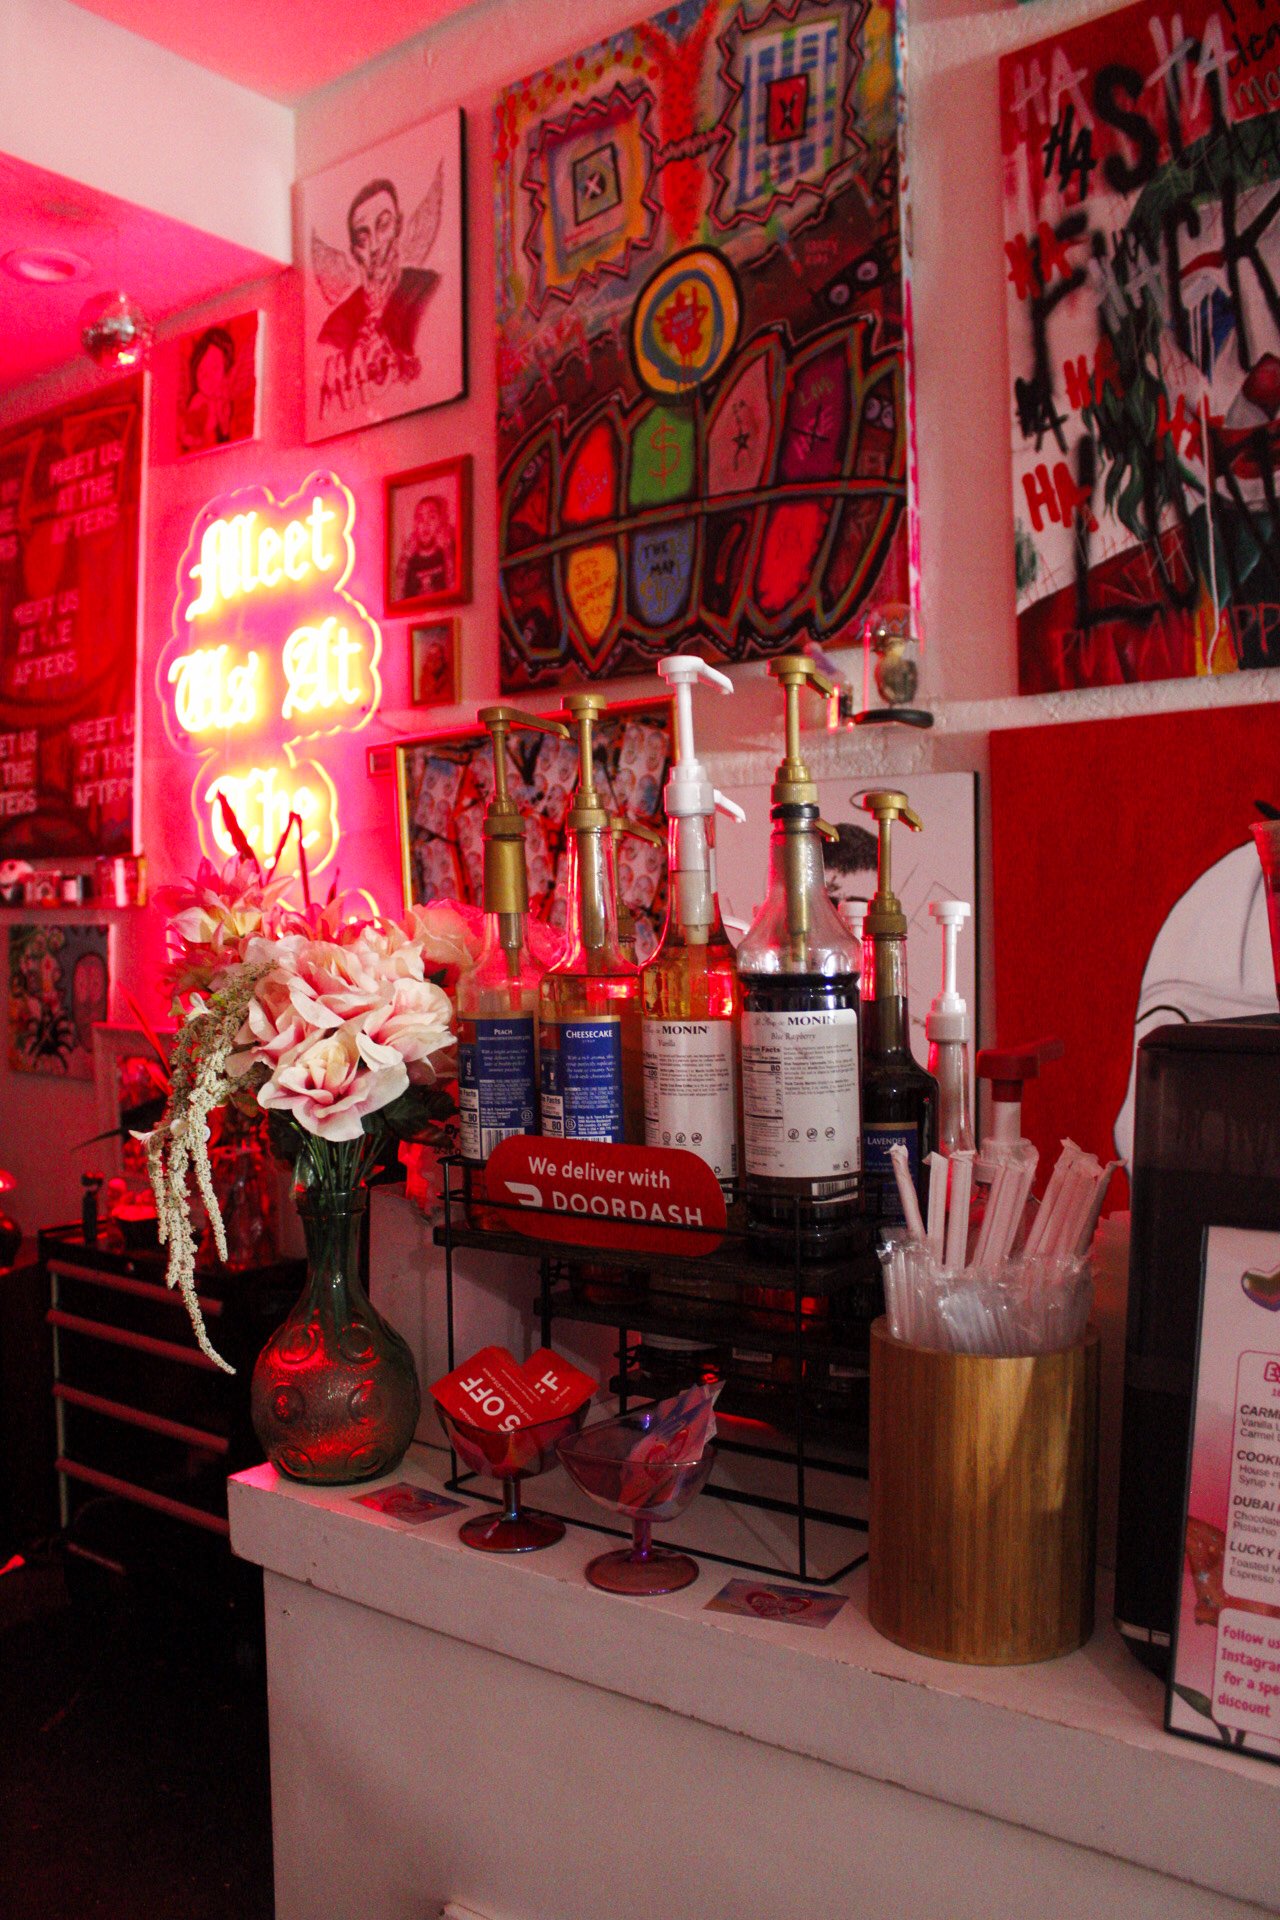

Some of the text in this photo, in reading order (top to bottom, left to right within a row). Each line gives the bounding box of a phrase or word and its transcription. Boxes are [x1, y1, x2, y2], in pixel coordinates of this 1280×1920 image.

[184, 496, 336, 622] Meet
[167, 615, 363, 733] Us At
[662, 1025, 708, 1034] MONIN
[787, 1016, 837, 1026] MONIN
[528, 1156, 671, 1189] We deliver with
[552, 1191, 703, 1227] DOORDASH
[459, 1375, 505, 1416] OFF
[1241, 1417, 1273, 1430] Vanilla
[1240, 1428, 1275, 1441] Carmel
[1240, 1464, 1270, 1478] House
[1239, 1475, 1267, 1488] Syrup
[1233, 1494, 1275, 1511] DUBAI
[1233, 1520, 1277, 1537] Pistachio
[1229, 1540, 1275, 1558] LUCKY
[1231, 1556, 1270, 1572] Toasted
[1229, 1567, 1275, 1583] Espresso
[1223, 1625, 1264, 1645] Follow
[1223, 1671, 1244, 1686] for
[1246, 1680, 1255, 1689] a
[1218, 1692, 1272, 1718] discount
